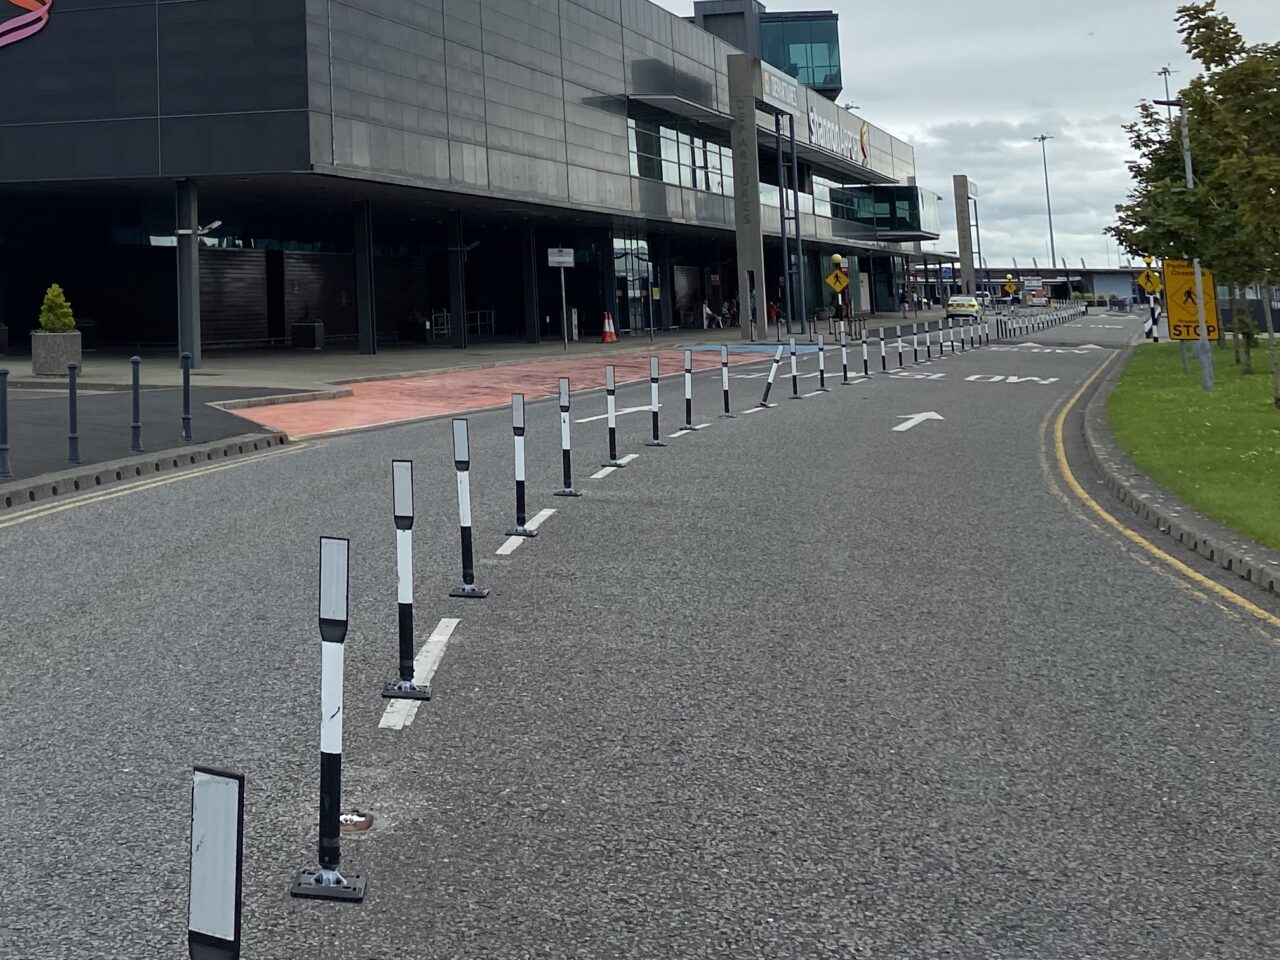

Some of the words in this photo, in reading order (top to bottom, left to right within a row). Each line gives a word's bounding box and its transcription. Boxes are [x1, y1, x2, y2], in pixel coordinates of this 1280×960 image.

[809, 106, 839, 153] shannon
[840, 127, 860, 161] AIRPORT
[735, 99, 751, 224] DEPARTURES
[1173, 325, 1215, 337] STOP
[889, 371, 1060, 384] SLOW
